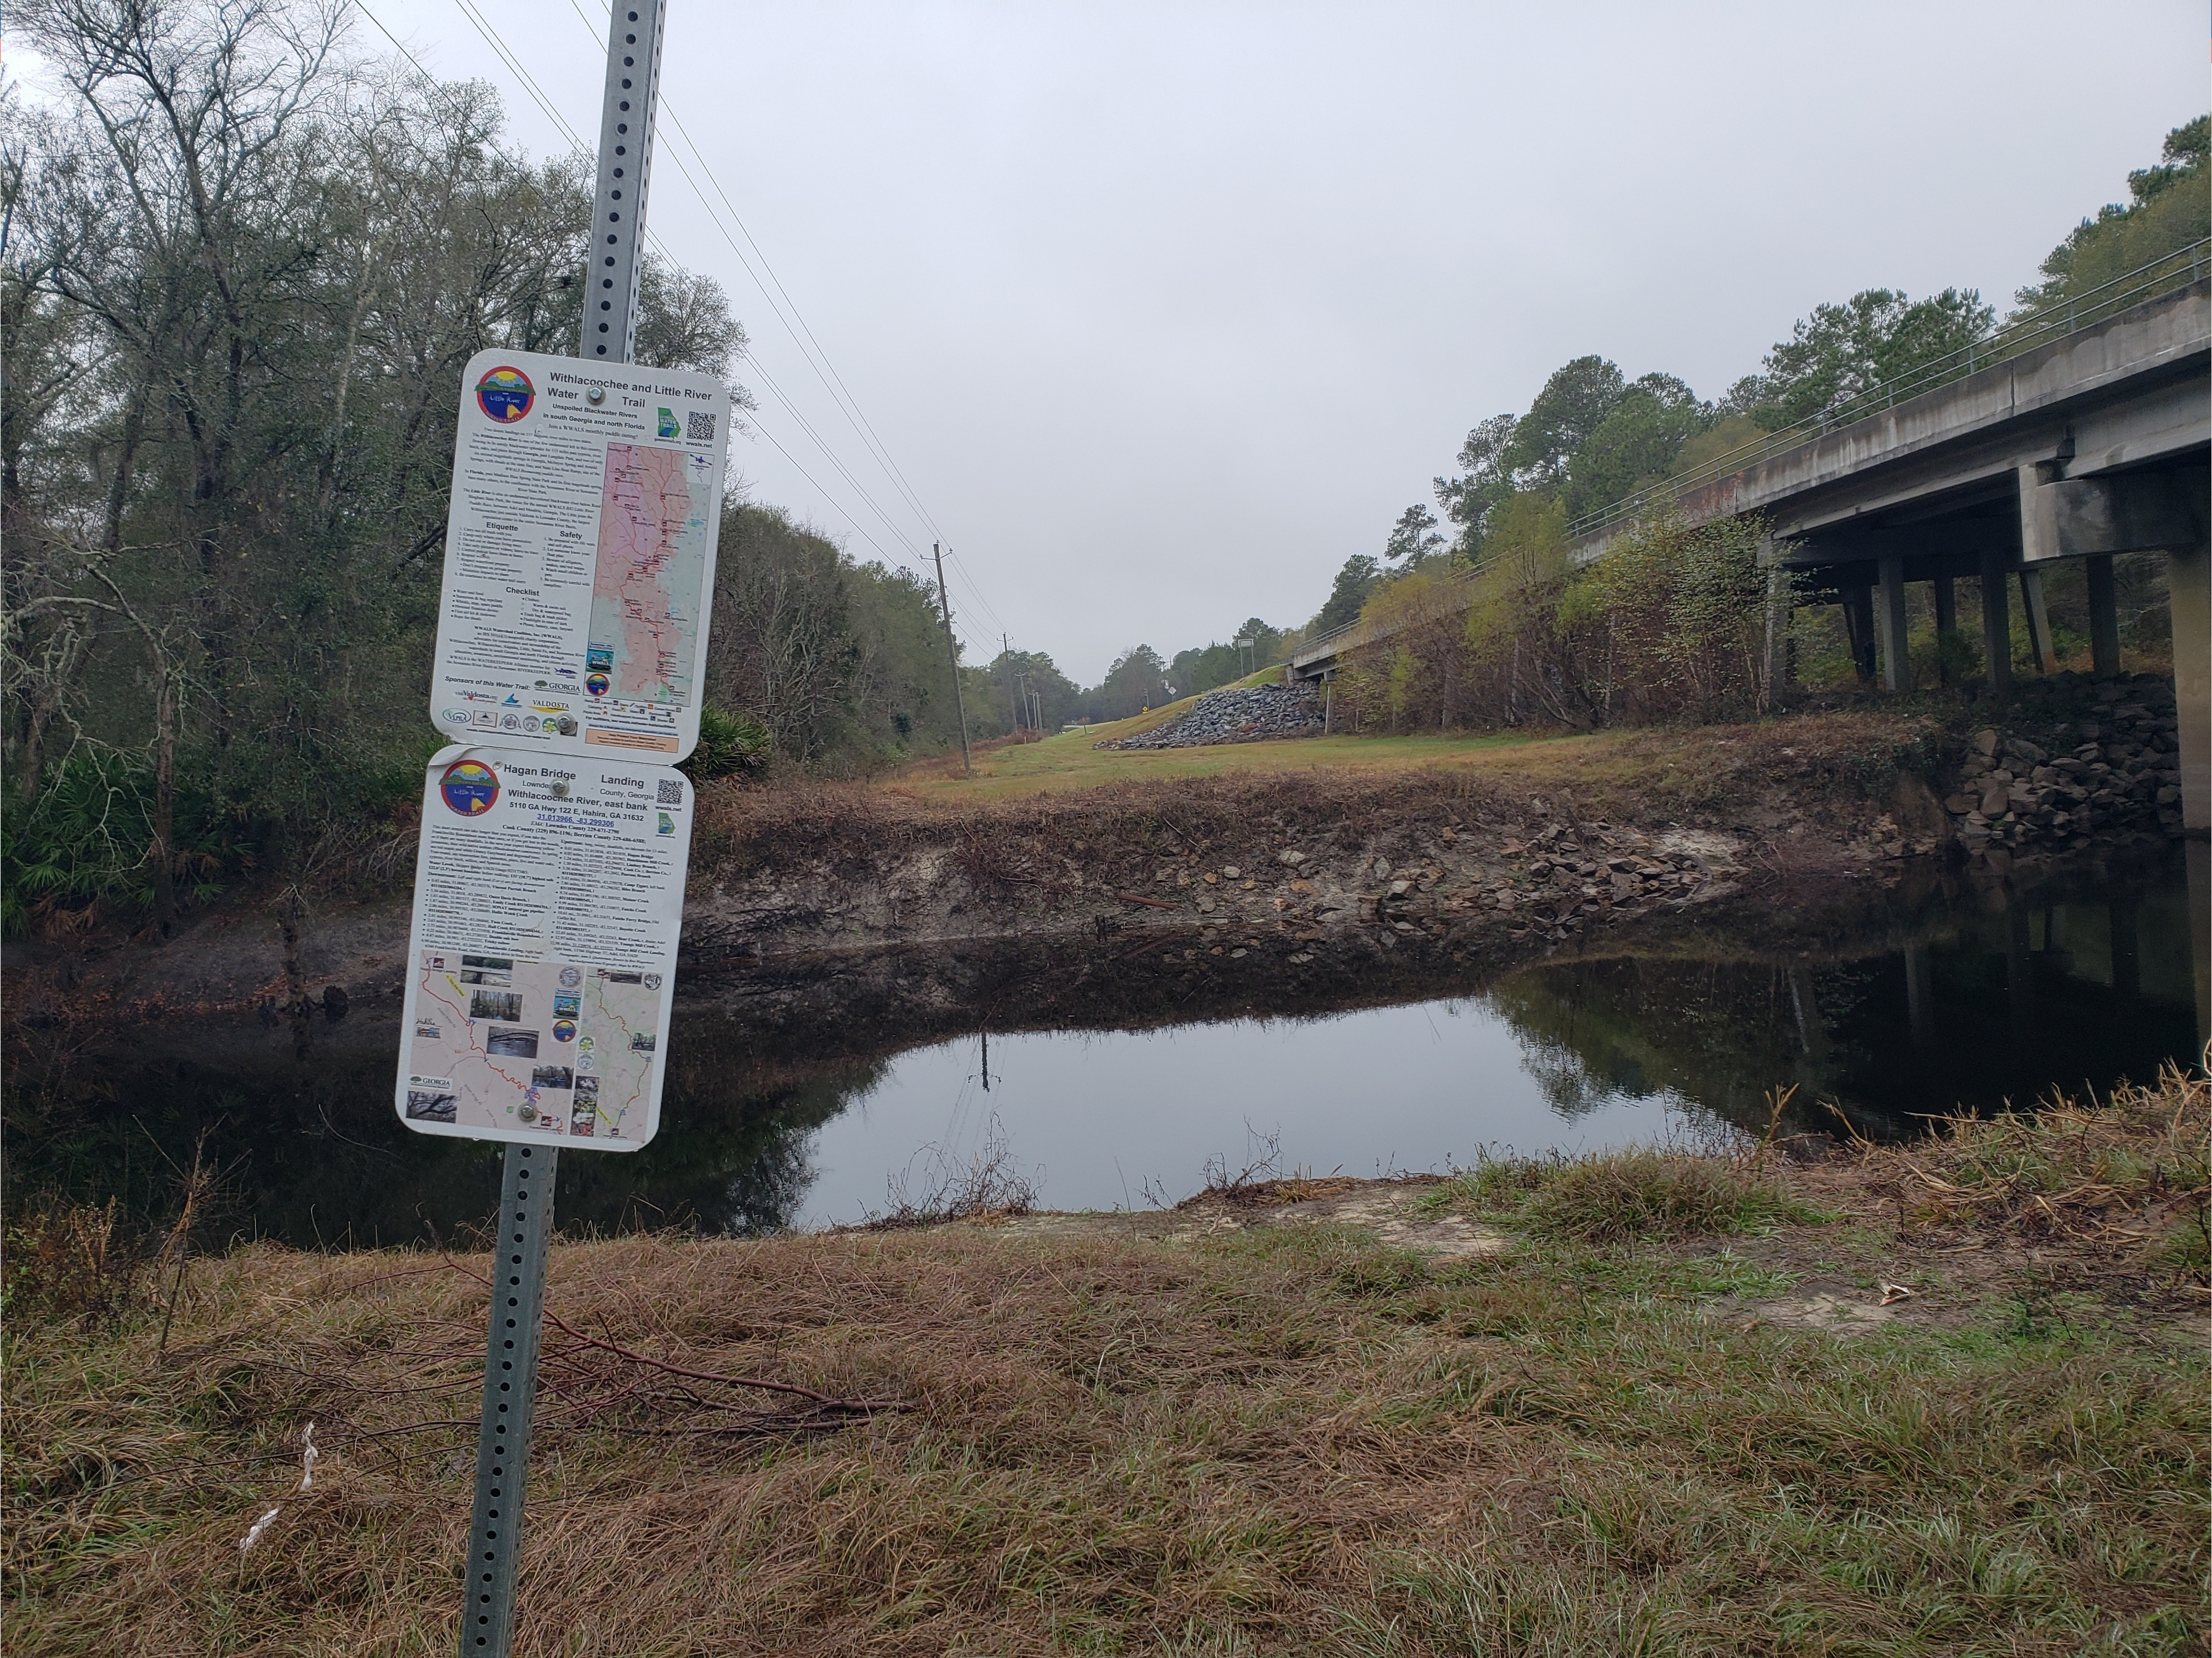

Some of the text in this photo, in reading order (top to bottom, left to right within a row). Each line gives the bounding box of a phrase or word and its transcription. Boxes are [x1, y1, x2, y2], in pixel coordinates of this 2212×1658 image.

[550, 372, 712, 400] Withlacoochee and Little River
[548, 387, 645, 407] Water Trail
[553, 404, 583, 412] Unspoiled
[584, 407, 617, 416] Blackwater
[569, 416, 592, 424] Georgia
[486, 522, 518, 531] Etiquette
[560, 531, 582, 540] Safety
[506, 587, 540, 597] Checklist
[445, 676, 474, 684] Sponsors
[549, 683, 581, 693] GEORGIA
[532, 700, 569, 709] VALDOSTA
[504, 764, 644, 789] Hagan Bridge Landing
[523, 780, 654, 800] Lownde County, Georgia
[576, 796, 602, 807] River,
[626, 802, 648, 811] bank
[541, 805, 557, 814] Hwy
[582, 809, 608, 819] Hahira,
[576, 817, 614, 828] -83.299306
